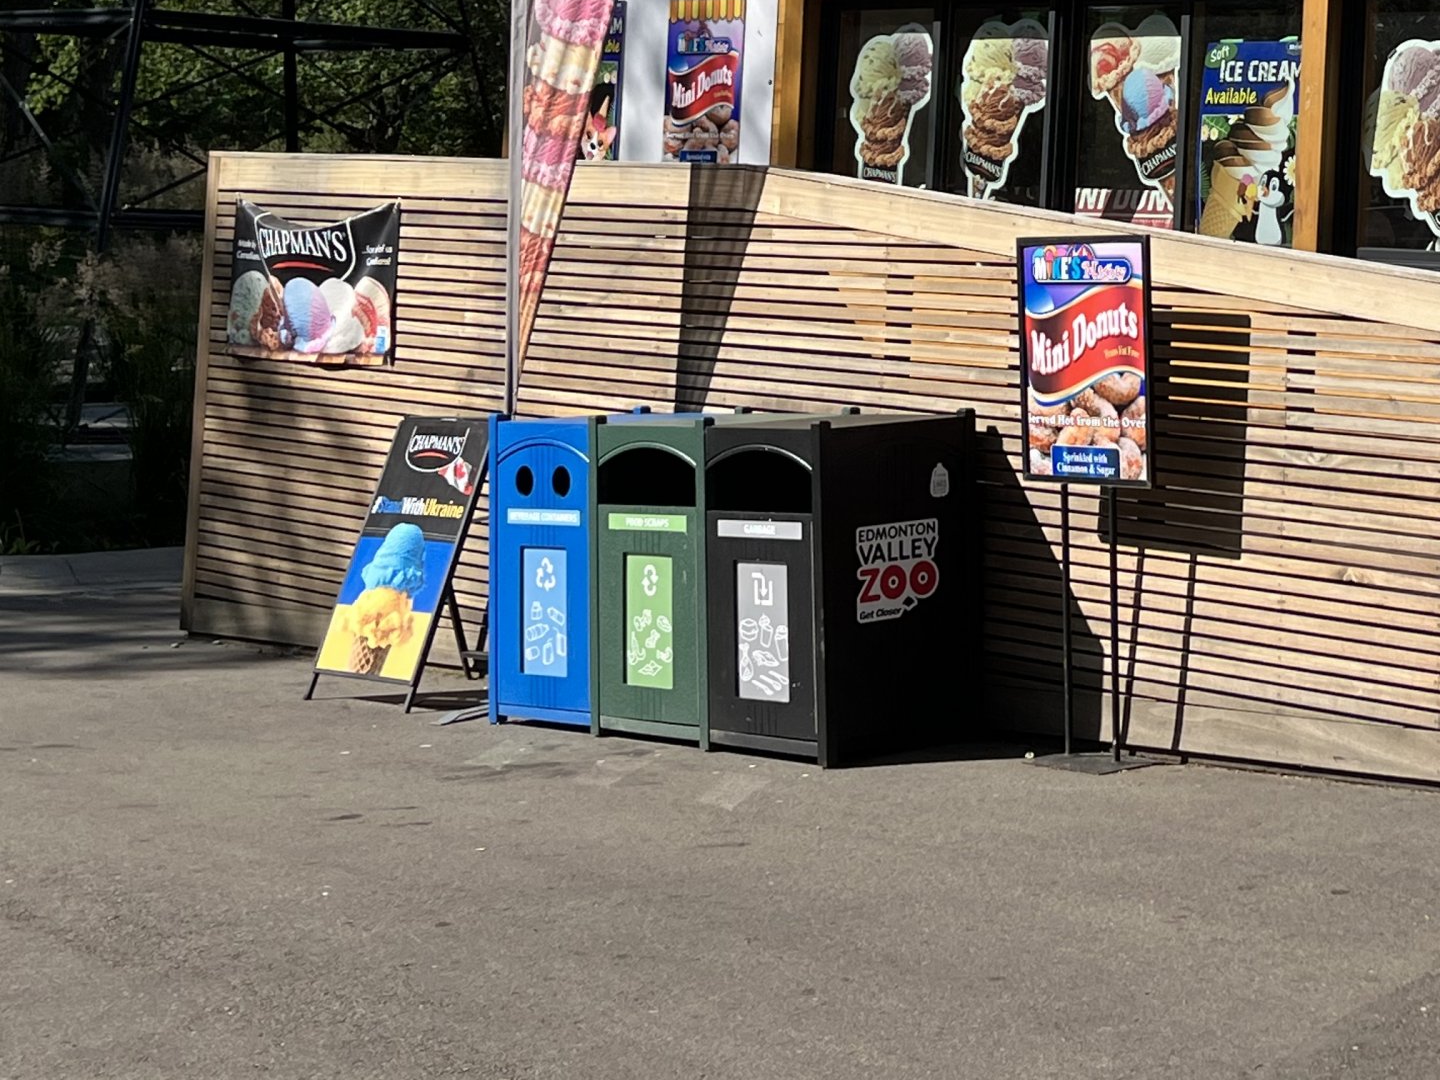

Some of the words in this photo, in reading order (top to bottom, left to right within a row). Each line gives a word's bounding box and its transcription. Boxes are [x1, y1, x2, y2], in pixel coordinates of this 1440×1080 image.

[1210, 45, 1230, 62] Soft
[1219, 60, 1244, 83] ICE
[1247, 60, 1302, 82] CREAM
[672, 81, 696, 108] Mini
[696, 65, 733, 101] Donuts
[1204, 87, 1257, 105] Available
[1142, 143, 1177, 175] CHAPMAN
[258, 228, 347, 262] CHAPMAN'S
[1031, 328, 1069, 375] Mini
[1073, 301, 1138, 362] Donuts
[1058, 415, 1075, 425] Hot
[1077, 416, 1100, 426] from
[1103, 417, 1119, 427] the
[409, 434, 462, 455] CHAPMAN'S
[1063, 451, 1093, 464] Sprinkled
[1094, 453, 1108, 463] with
[1096, 464, 1116, 477] Sugar
[625, 517, 643, 527] FOOD
[644, 518, 670, 529] SCRAPS
[743, 524, 776, 535] GARBAGE
[858, 521, 936, 543] EDMONTON
[859, 536, 937, 565] VALLEY
[859, 560, 937, 603] ZOO
[859, 609, 874, 620] Get
[876, 608, 902, 618] Closer
